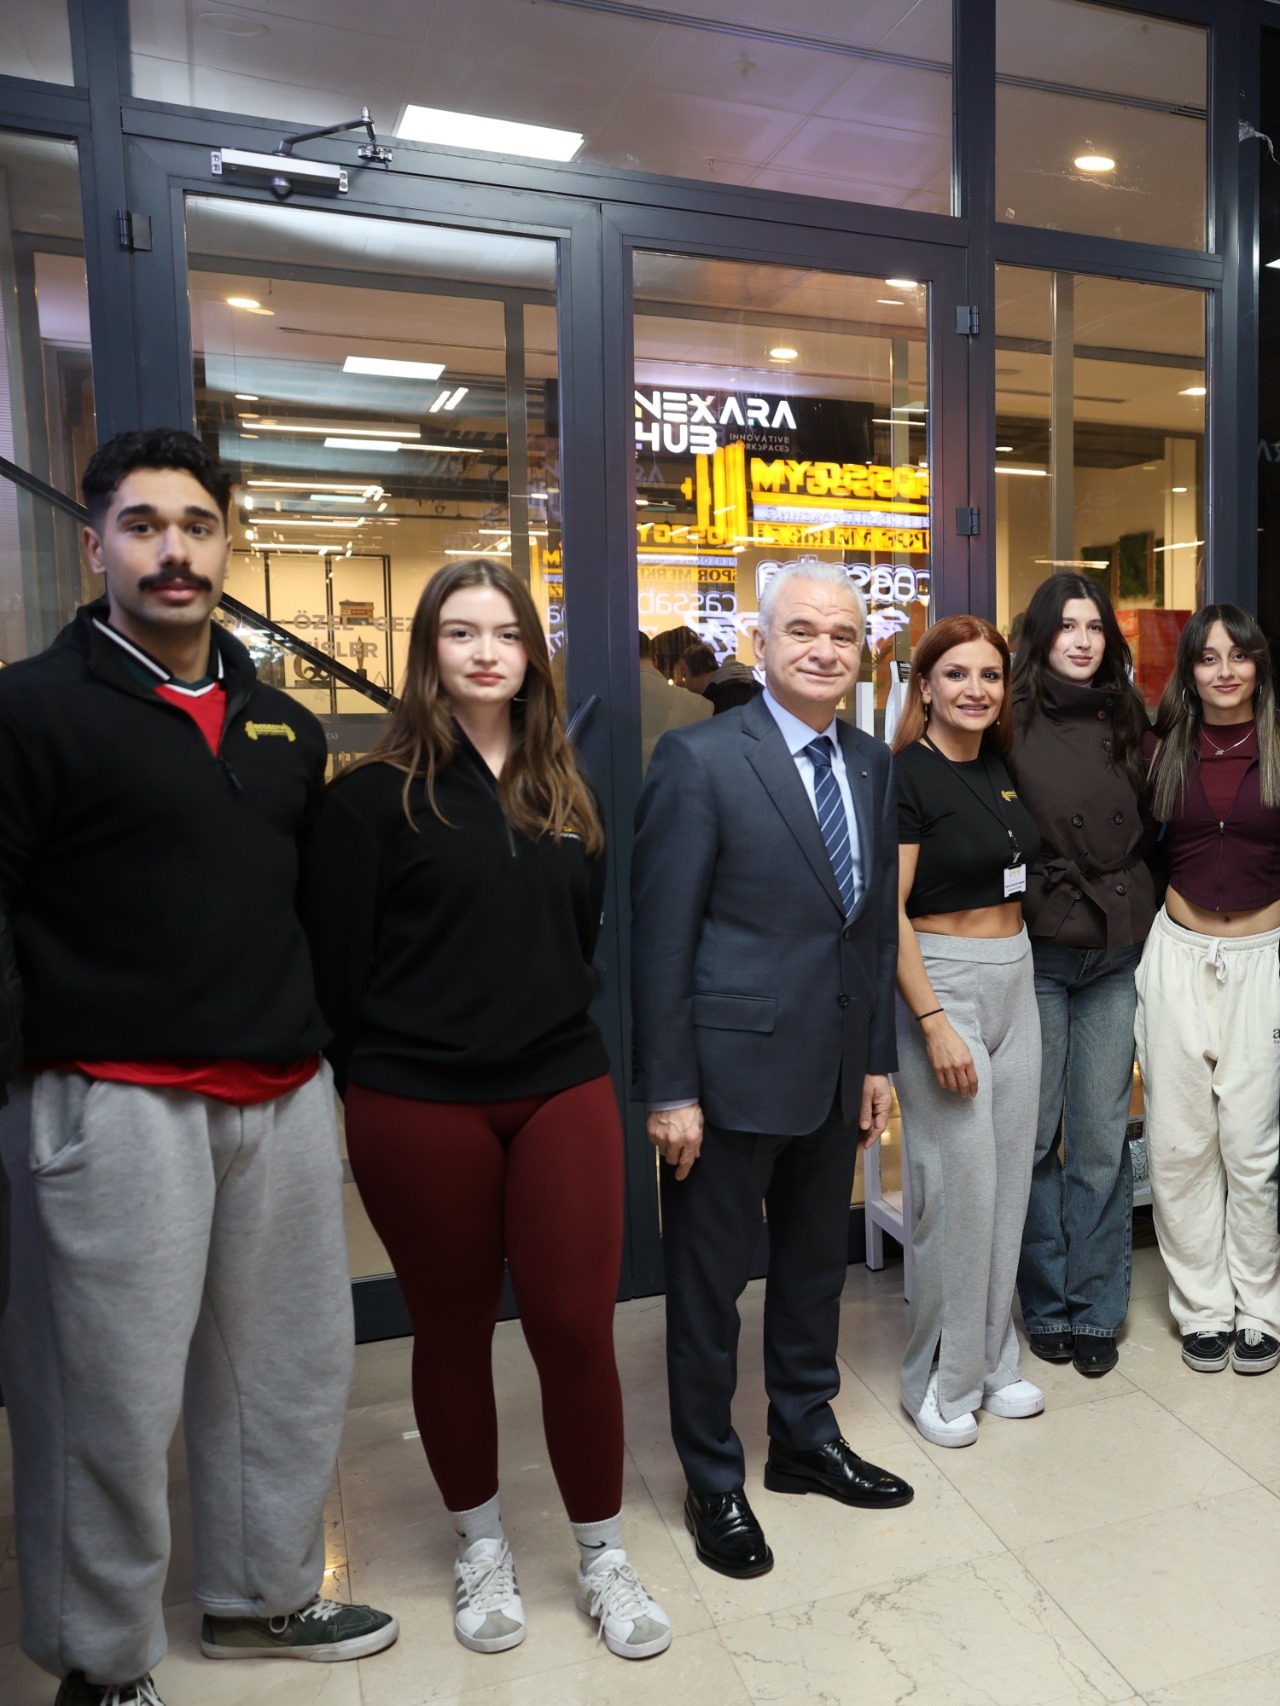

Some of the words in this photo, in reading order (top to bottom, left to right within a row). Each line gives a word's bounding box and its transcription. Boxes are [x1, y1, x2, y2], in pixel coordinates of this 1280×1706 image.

[634, 390, 797, 429] NEXARA
[634, 421, 718, 455] HUB
[729, 433, 790, 444] INNOVATIVE
[293, 610, 354, 631] ÖZEL
[306, 638, 378, 661] İŞLER
